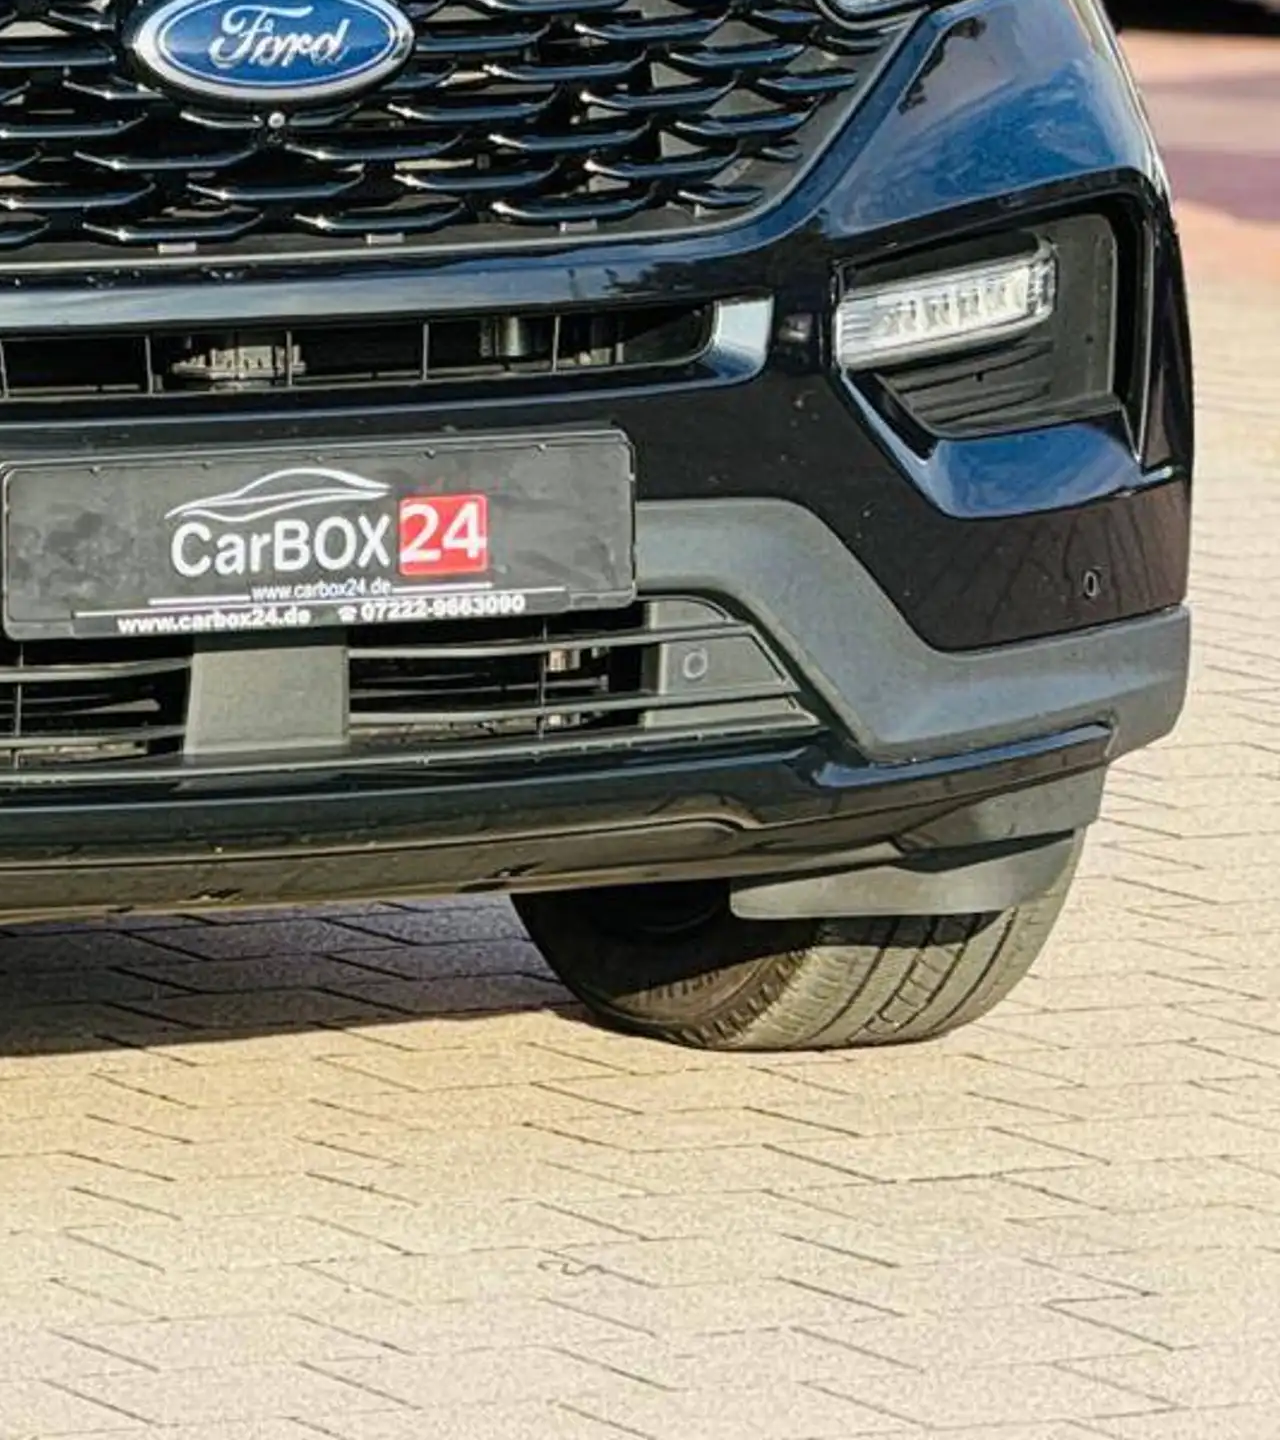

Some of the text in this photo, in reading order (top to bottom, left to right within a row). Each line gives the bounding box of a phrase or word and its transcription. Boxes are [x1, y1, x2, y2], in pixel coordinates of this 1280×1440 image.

[209, 5, 350, 68] Ford
[251, 578, 392, 602] www.carbox24.de
[117, 609, 311, 635] www.carbox24.de
